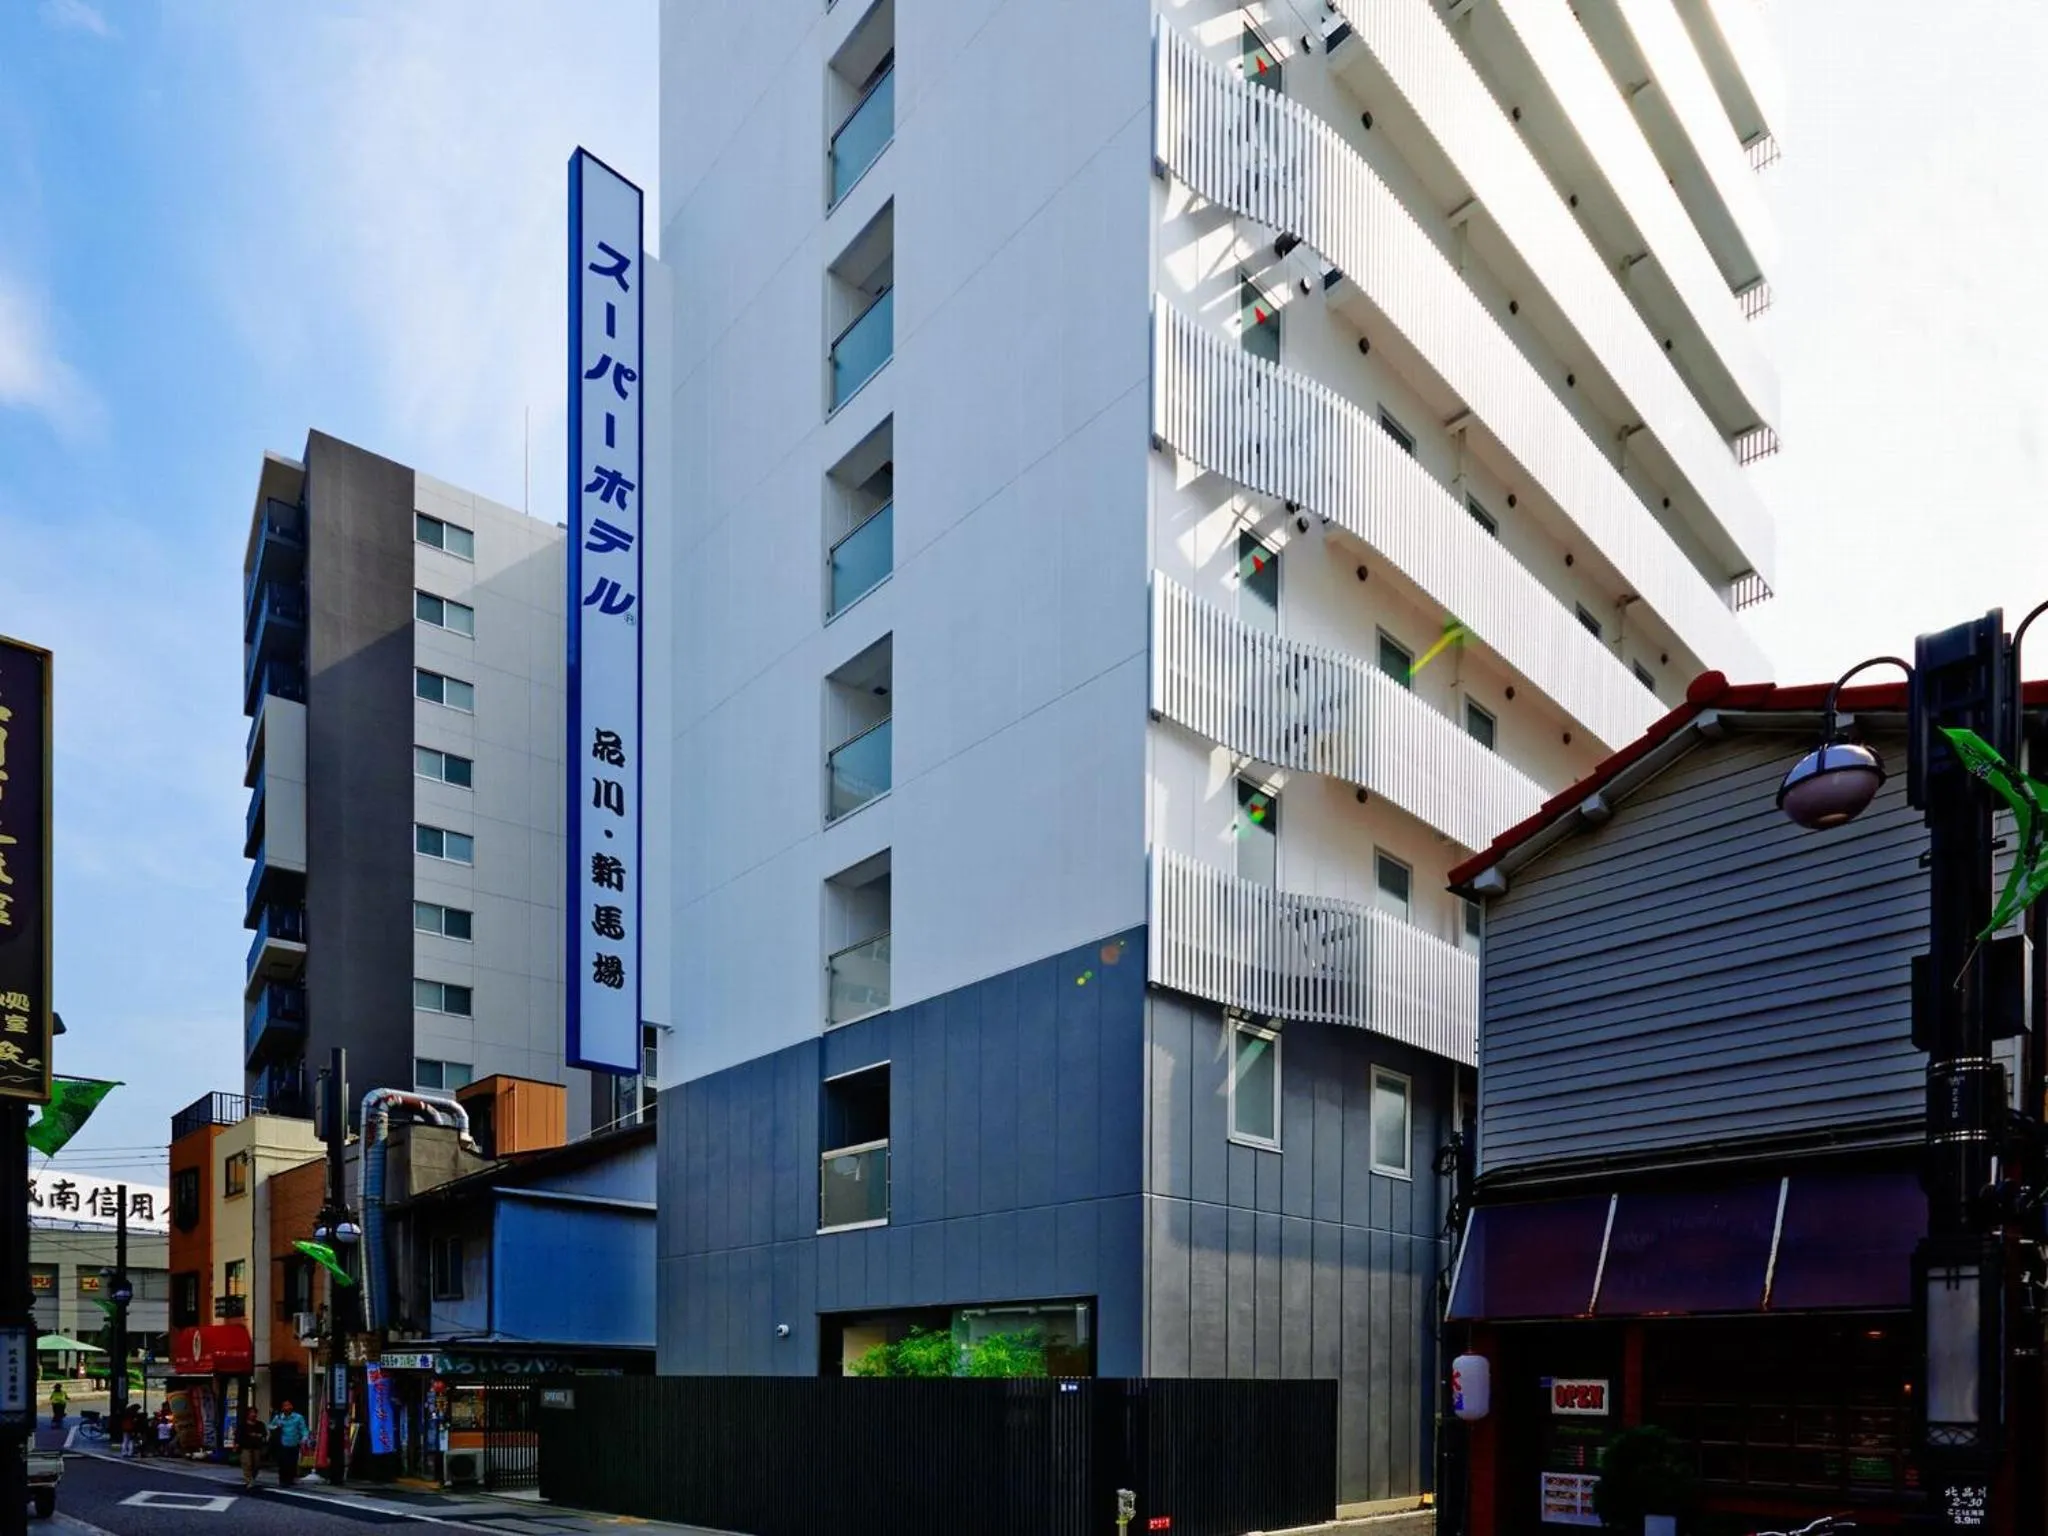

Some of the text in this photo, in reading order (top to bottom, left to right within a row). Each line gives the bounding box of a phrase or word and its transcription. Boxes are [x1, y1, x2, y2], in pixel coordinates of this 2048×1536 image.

[584, 241, 638, 615] スーパーホテル
[592, 727, 626, 990] 品川・新馬場
[27, 1178, 169, 1220] 南信用
[1556, 1385, 1604, 1408] OPEN
[1945, 1486, 1987, 1498] 北品川
[1954, 1516, 1981, 1525] 3.9m
